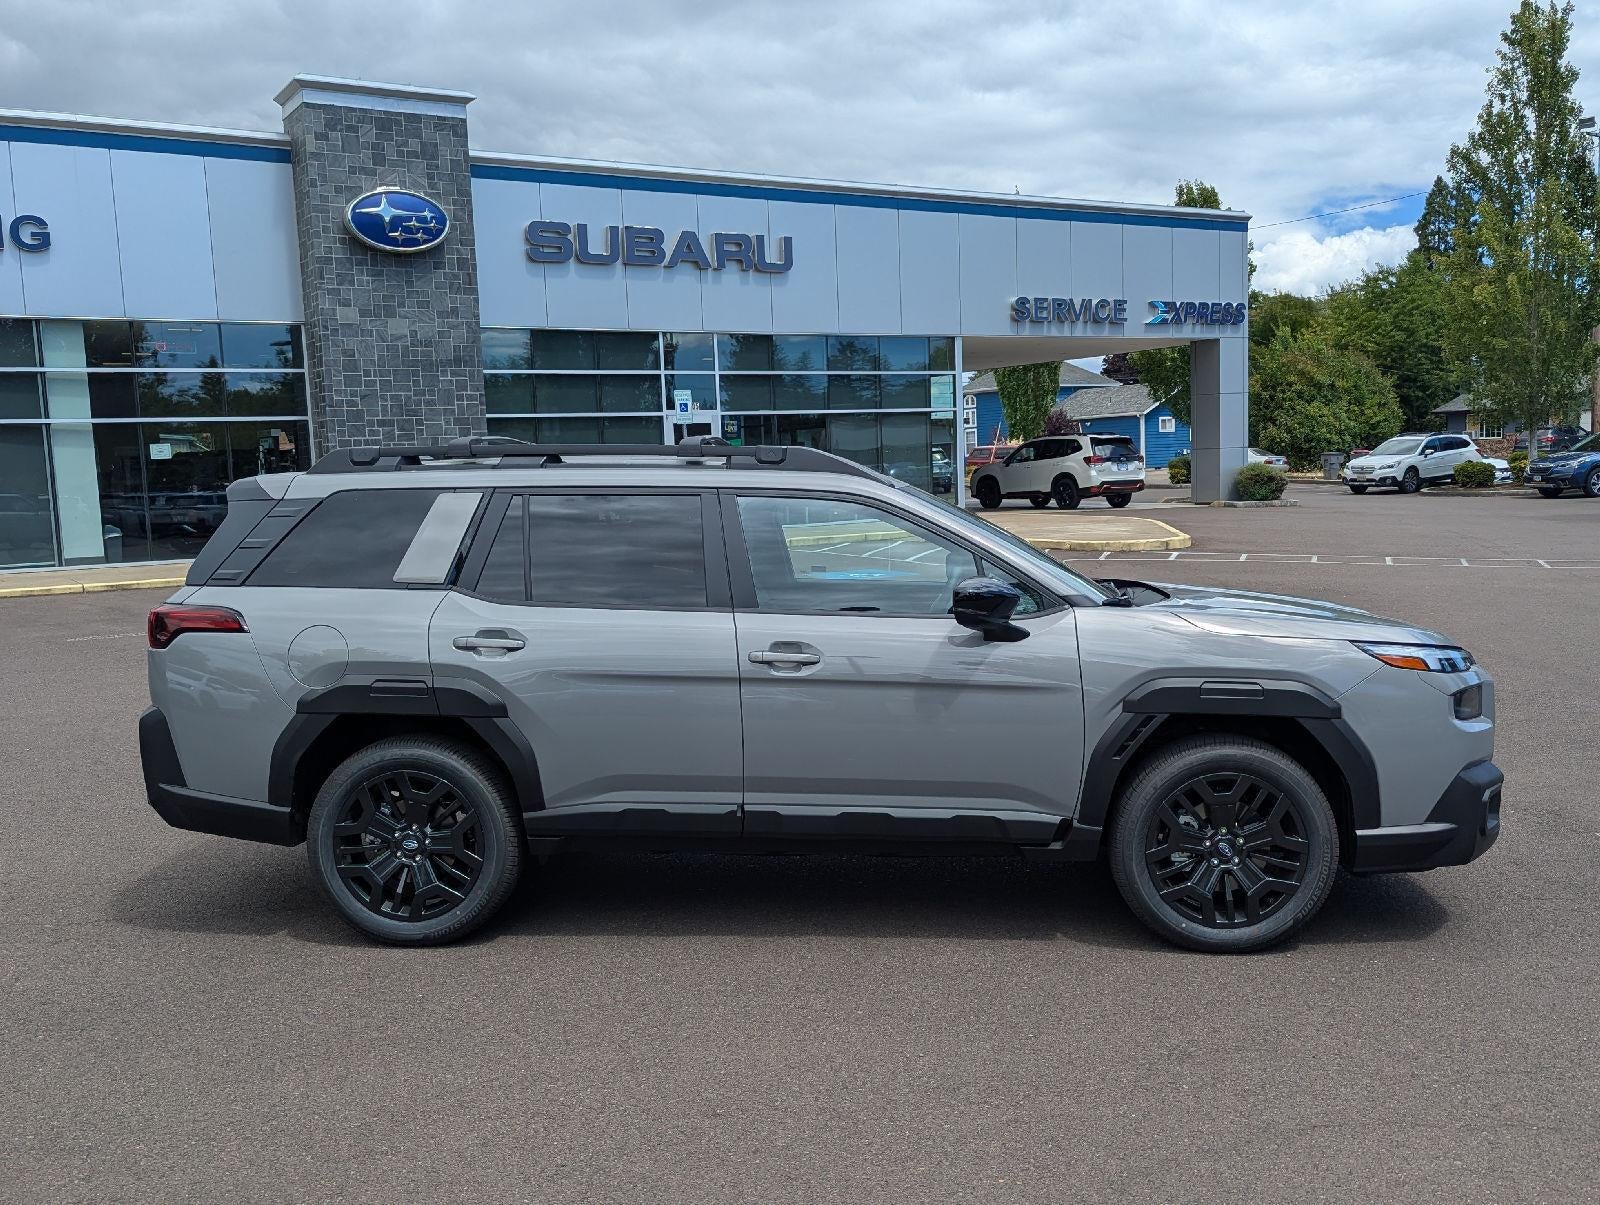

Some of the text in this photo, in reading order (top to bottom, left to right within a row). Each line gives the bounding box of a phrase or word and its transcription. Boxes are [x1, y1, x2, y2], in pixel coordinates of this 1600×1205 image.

[0, 214, 51, 252] G
[525, 220, 793, 273] SUBARU
[1012, 296, 1246, 326] SERVICE EXPRESS
